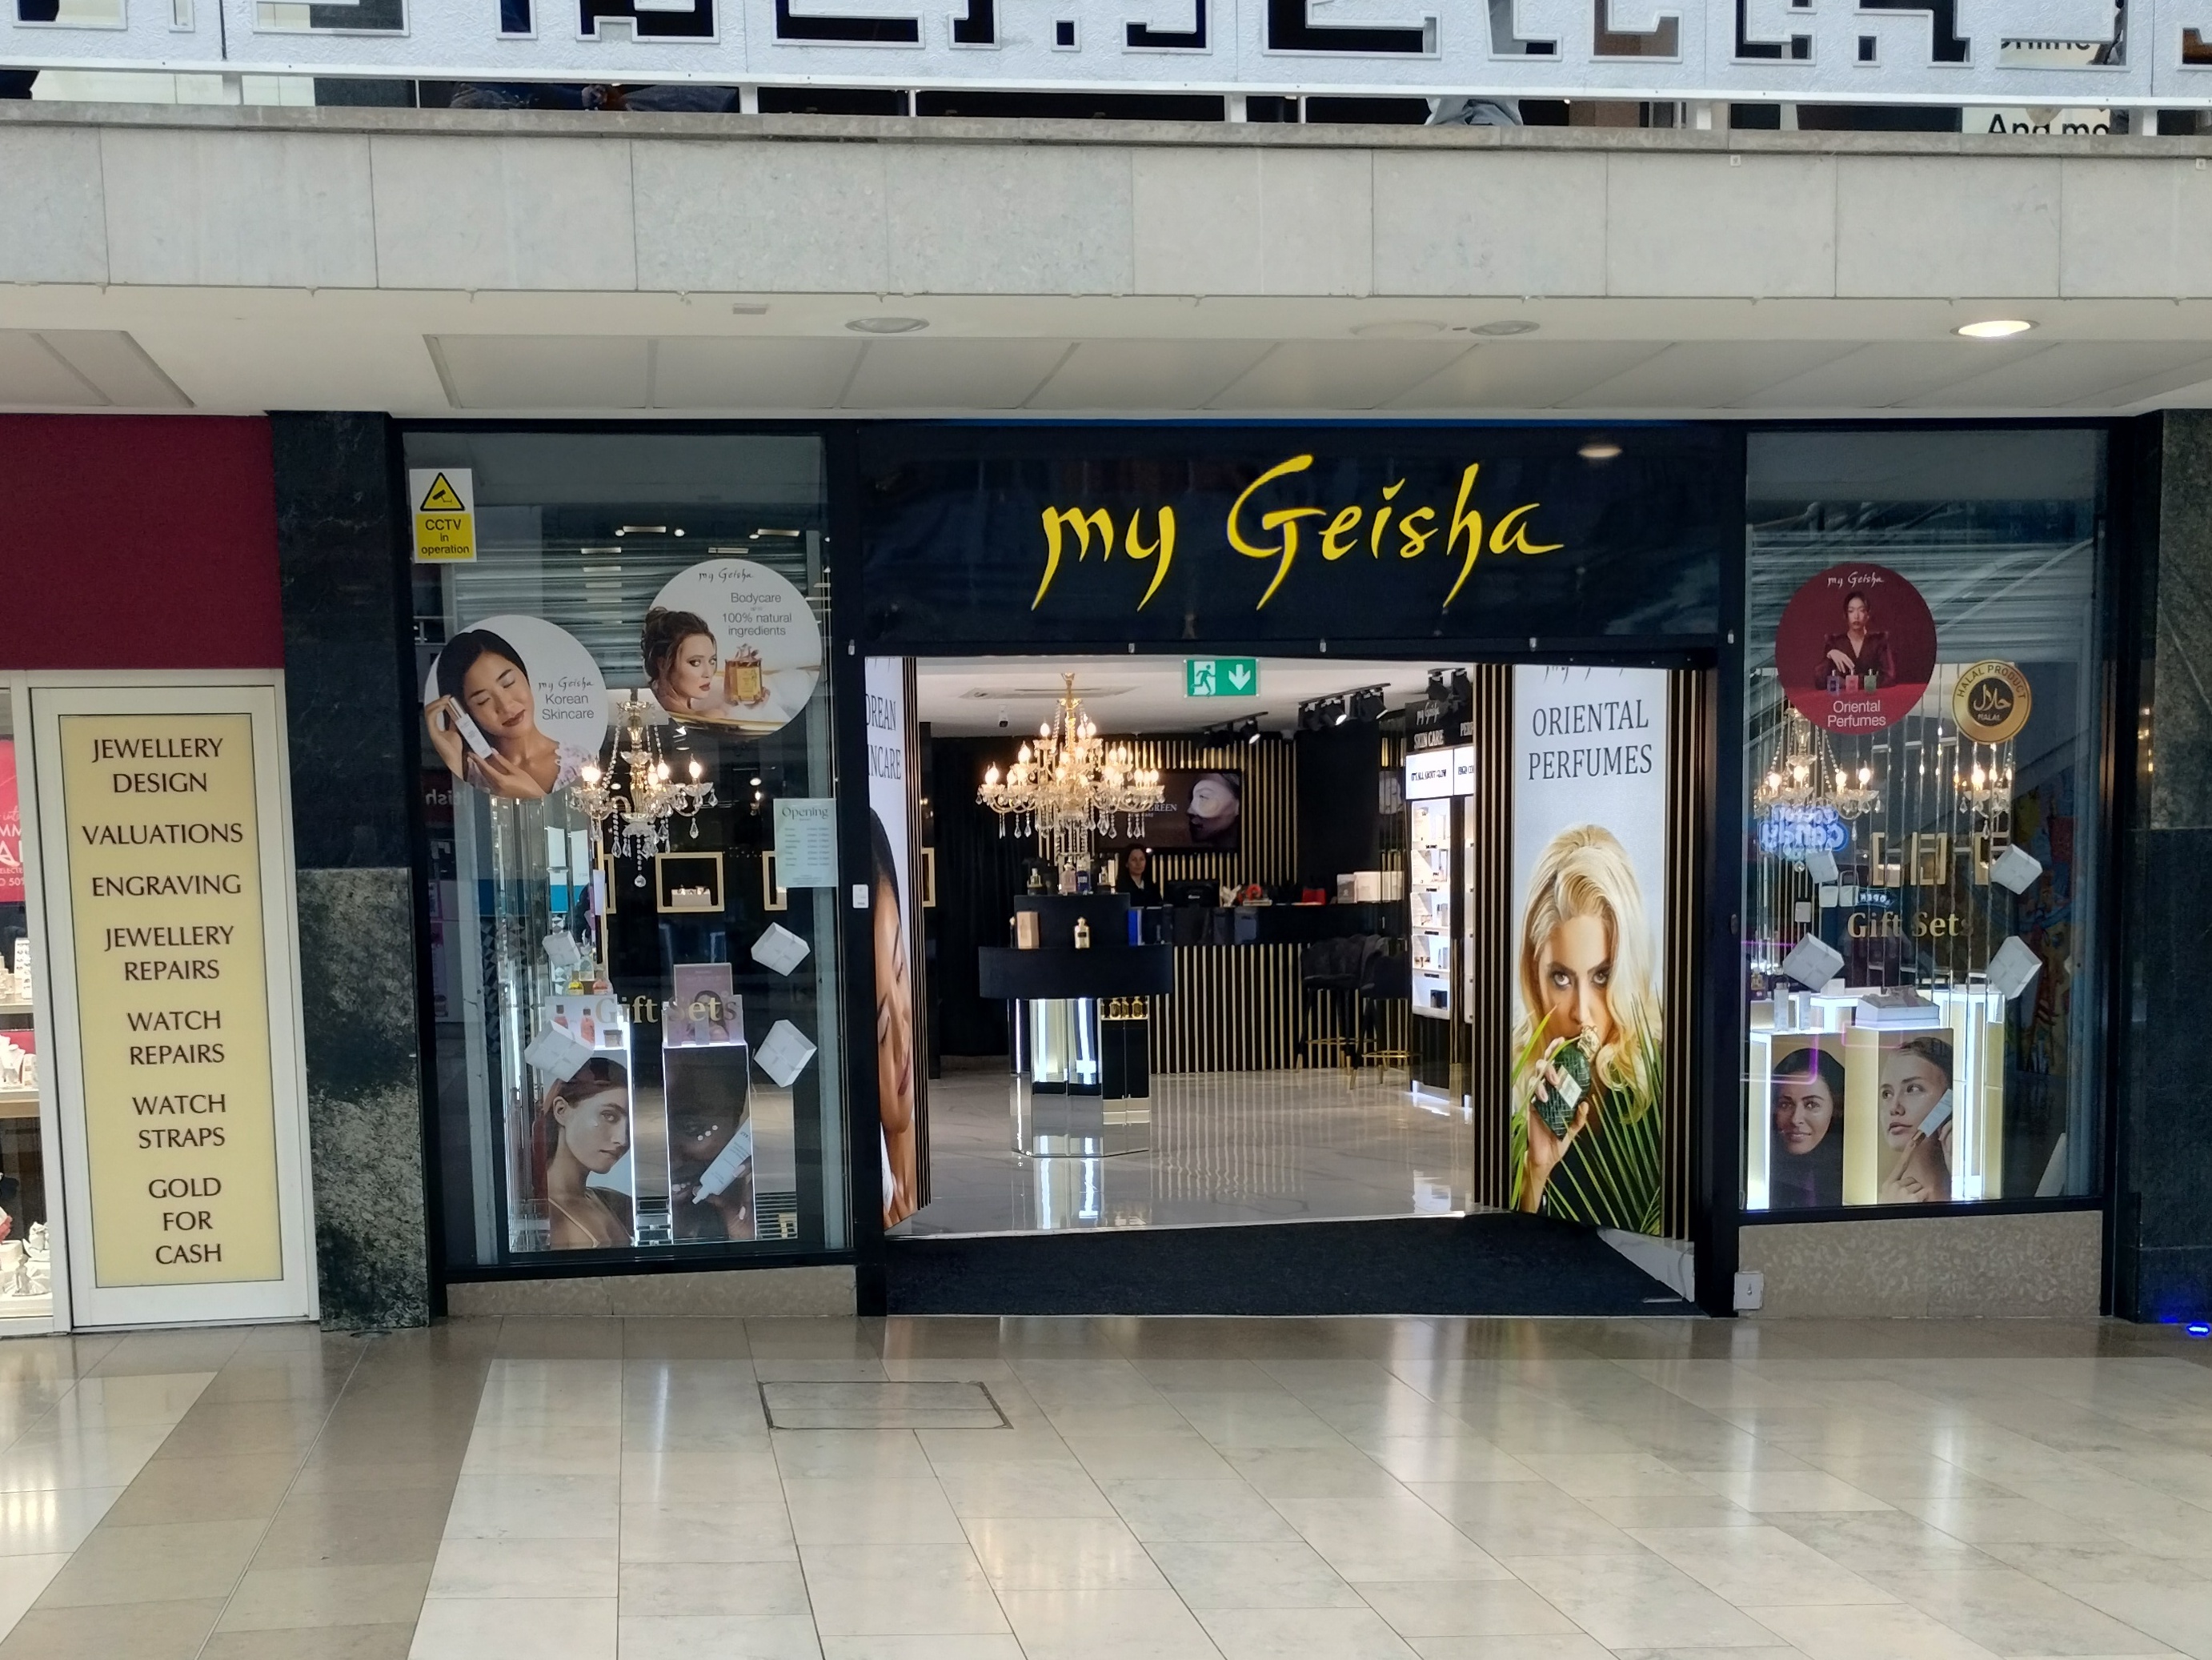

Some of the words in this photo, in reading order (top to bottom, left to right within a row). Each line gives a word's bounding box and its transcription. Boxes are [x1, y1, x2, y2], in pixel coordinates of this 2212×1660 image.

[425, 519, 462, 531] CCTV
[1032, 506, 1175, 612] my
[1227, 454, 1565, 611] Geisha
[440, 533, 449, 542] in
[421, 545, 470, 556] operation
[699, 572, 714, 583] my
[719, 567, 753, 583] Geisha
[1827, 577, 1843, 589] my
[1847, 571, 1885, 588] Geisha
[731, 592, 782, 604] Bodycare
[723, 612, 752, 623] 100%
[755, 612, 792, 623] natural
[728, 625, 787, 638] ingredients
[539, 682, 554, 693] my
[558, 676, 595, 692] Geisha
[1957, 668, 1985, 697] HALAL
[1987, 664, 2026, 699] PRODUCT
[545, 693, 589, 705] Korean
[1833, 700, 1881, 713] Oriental
[1973, 684, 2012, 712] حلال
[542, 708, 595, 720] Skincare
[865, 693, 896, 732] OREAN
[1533, 700, 1649, 737] ORIENTAL
[1827, 714, 1886, 728] Perfumes
[92, 738, 223, 763] JEWELLERY
[1529, 744, 1653, 780] PERFUMES
[113, 772, 207, 793] DESIGN
[782, 807, 829, 820] Opening
[82, 823, 243, 845] VALUATIONS
[92, 874, 242, 896] ENGRAVING
[1848, 910, 1902, 938] Gift
[105, 925, 234, 952] JEWELLERY
[124, 960, 220, 982] REPAIRS
[595, 995, 659, 1024] Gift
[666, 996, 737, 1024] Sets
[127, 1010, 222, 1032] WATCH
[130, 1043, 225, 1065] REPAIRS
[132, 1093, 226, 1116] WATCH
[138, 1127, 226, 1149] STRAPS
[148, 1177, 222, 1199] GOLD
[162, 1210, 214, 1231] FOR
[155, 1243, 222, 1265] CASH
